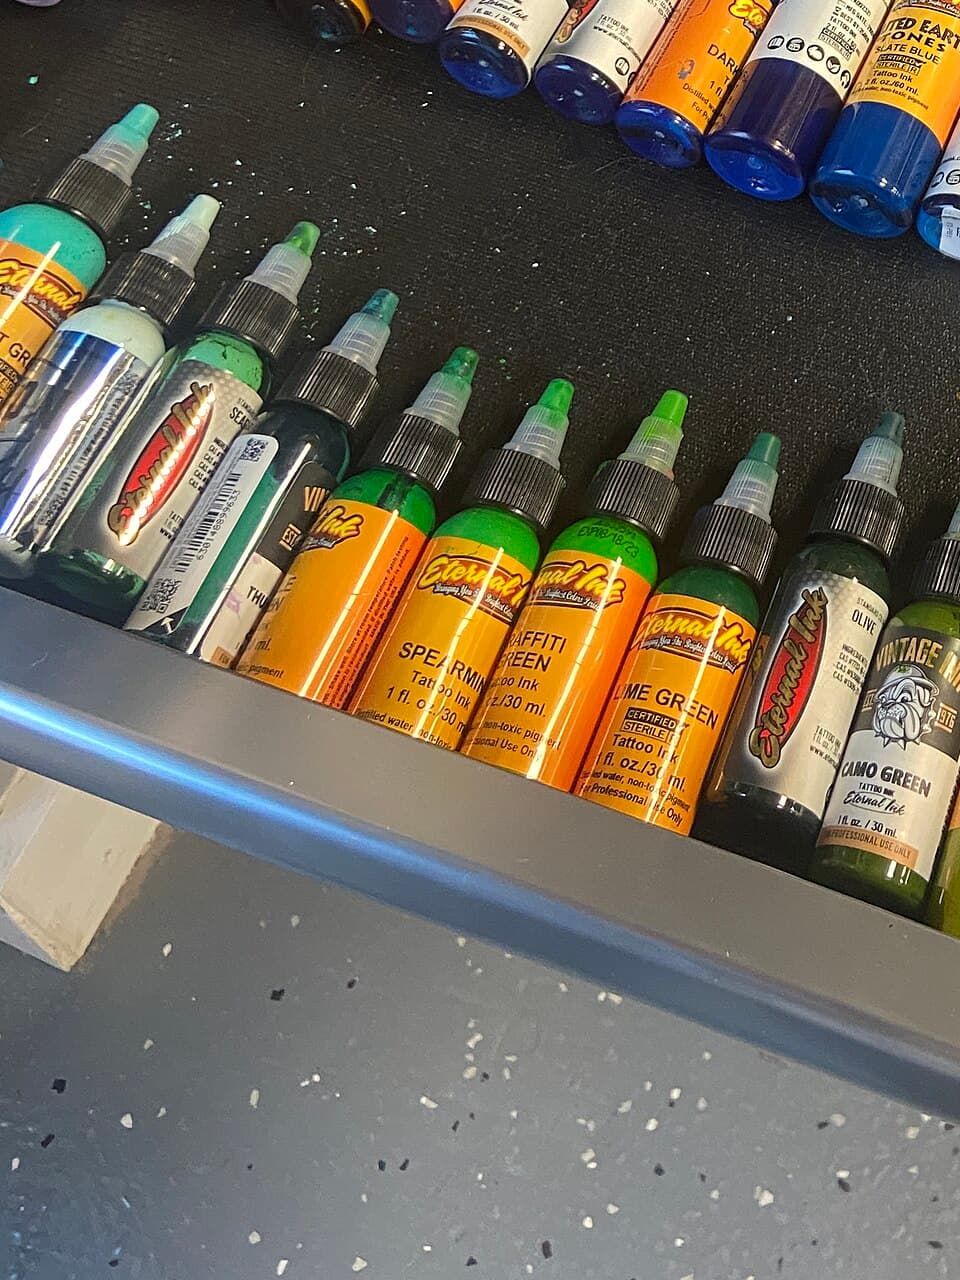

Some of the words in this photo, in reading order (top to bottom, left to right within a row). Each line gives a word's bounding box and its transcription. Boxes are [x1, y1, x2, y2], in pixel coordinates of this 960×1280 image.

[912, 47, 943, 65] BLUE
[873, 70, 899, 82] Tattoo
[899, 75, 914, 84] Ink
[851, 609, 878, 637] OLIVE
[875, 635, 944, 673] VINTAGE
[410, 670, 454, 699] Tattoo
[455, 692, 472, 710] Ink
[518, 678, 539, 691] Ink
[613, 682, 653, 703] LIME
[654, 687, 719, 731] GREEN
[749, 638, 808, 768] Eternal
[623, 720, 666, 740] STERILE
[628, 708, 677, 730] CERTIFIED
[612, 734, 654, 757] Tattoo
[656, 746, 680, 765] Ink
[840, 759, 879, 780] CAMO
[879, 762, 933, 799] GREEN
[858, 781, 882, 796] TATTOO
[843, 790, 887, 811] Eternal
[886, 799, 906, 817] Ink
